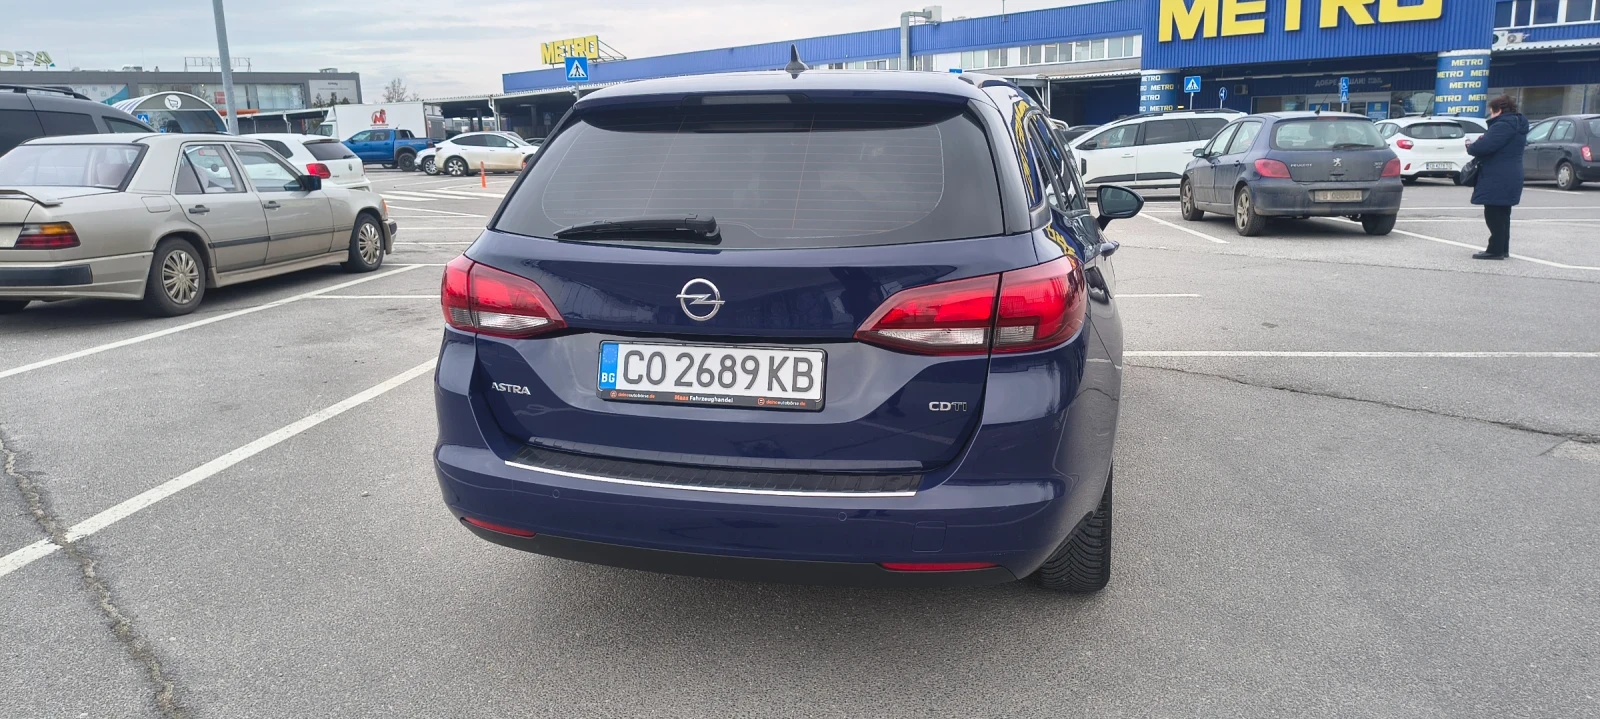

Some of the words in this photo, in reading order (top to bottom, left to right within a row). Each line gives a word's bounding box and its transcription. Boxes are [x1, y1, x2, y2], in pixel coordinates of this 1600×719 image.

[541, 35, 599, 65] METRO
[1452, 58, 1483, 66] METRO
[623, 350, 666, 385] CO
[674, 352, 760, 390] 2689
[767, 355, 814, 393] KB
[601, 372, 616, 383] BG
[492, 381, 531, 395] ASTRA
[689, 395, 734, 404] Fahrzeughandel
[929, 401, 967, 412] CDTI
